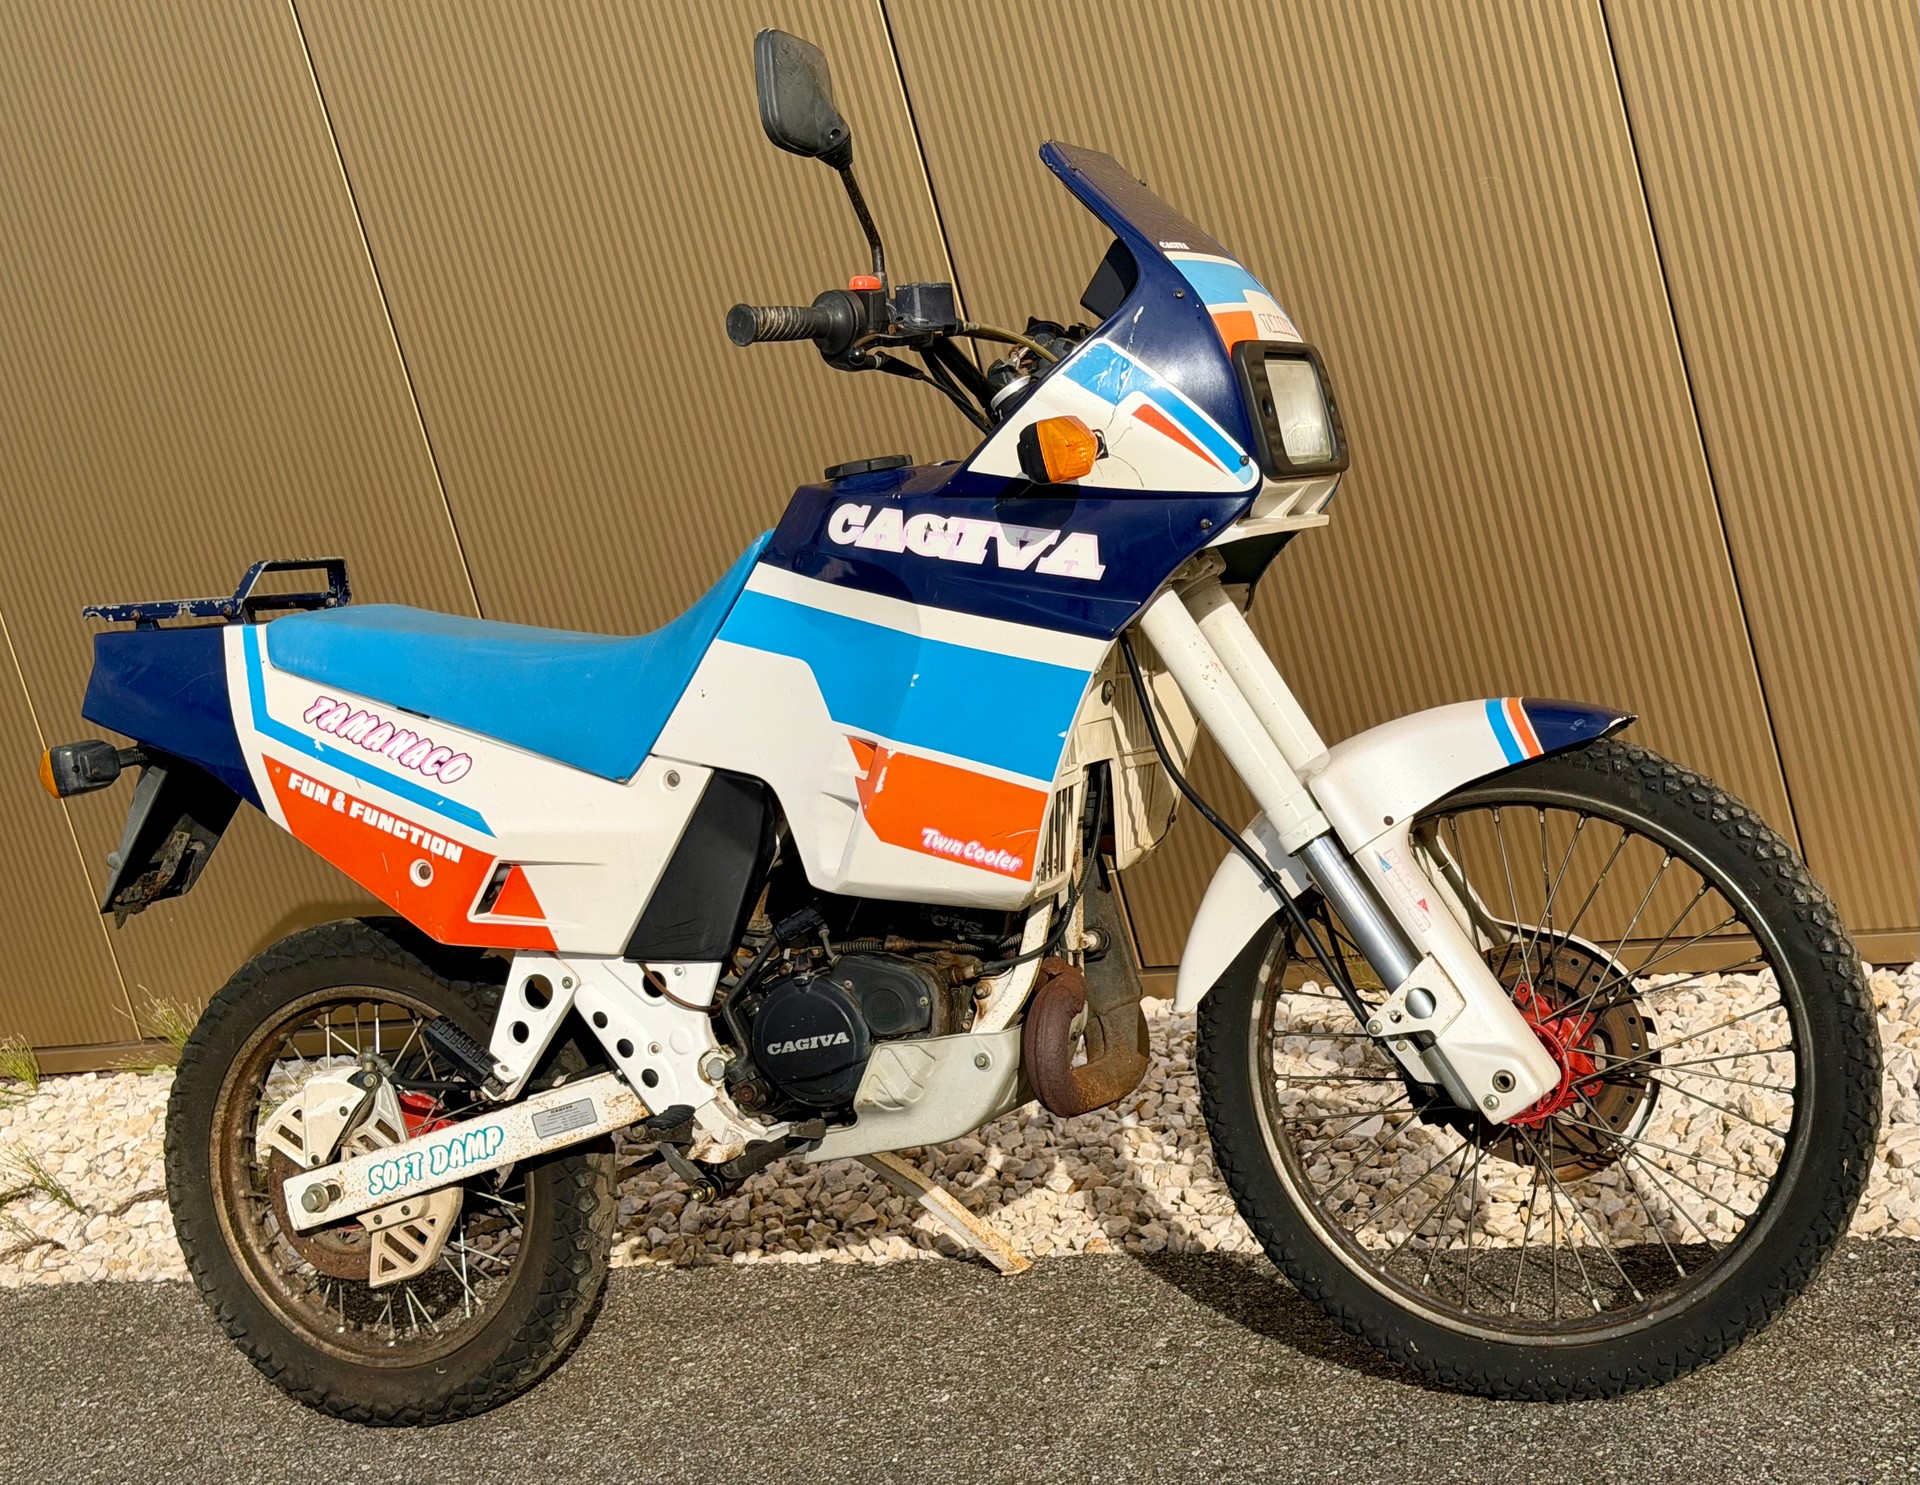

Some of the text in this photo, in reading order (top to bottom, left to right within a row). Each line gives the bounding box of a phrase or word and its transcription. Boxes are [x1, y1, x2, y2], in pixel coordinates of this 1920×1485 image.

[828, 503, 1106, 581] CAGIVA
[303, 695, 473, 784] TAMANACO
[288, 772, 463, 864] FUN & FUNCTION
[922, 827, 1023, 872] Twin Cooler
[766, 1031, 850, 1055] CAGIVA
[368, 1125, 505, 1196] SOFT DAMP
